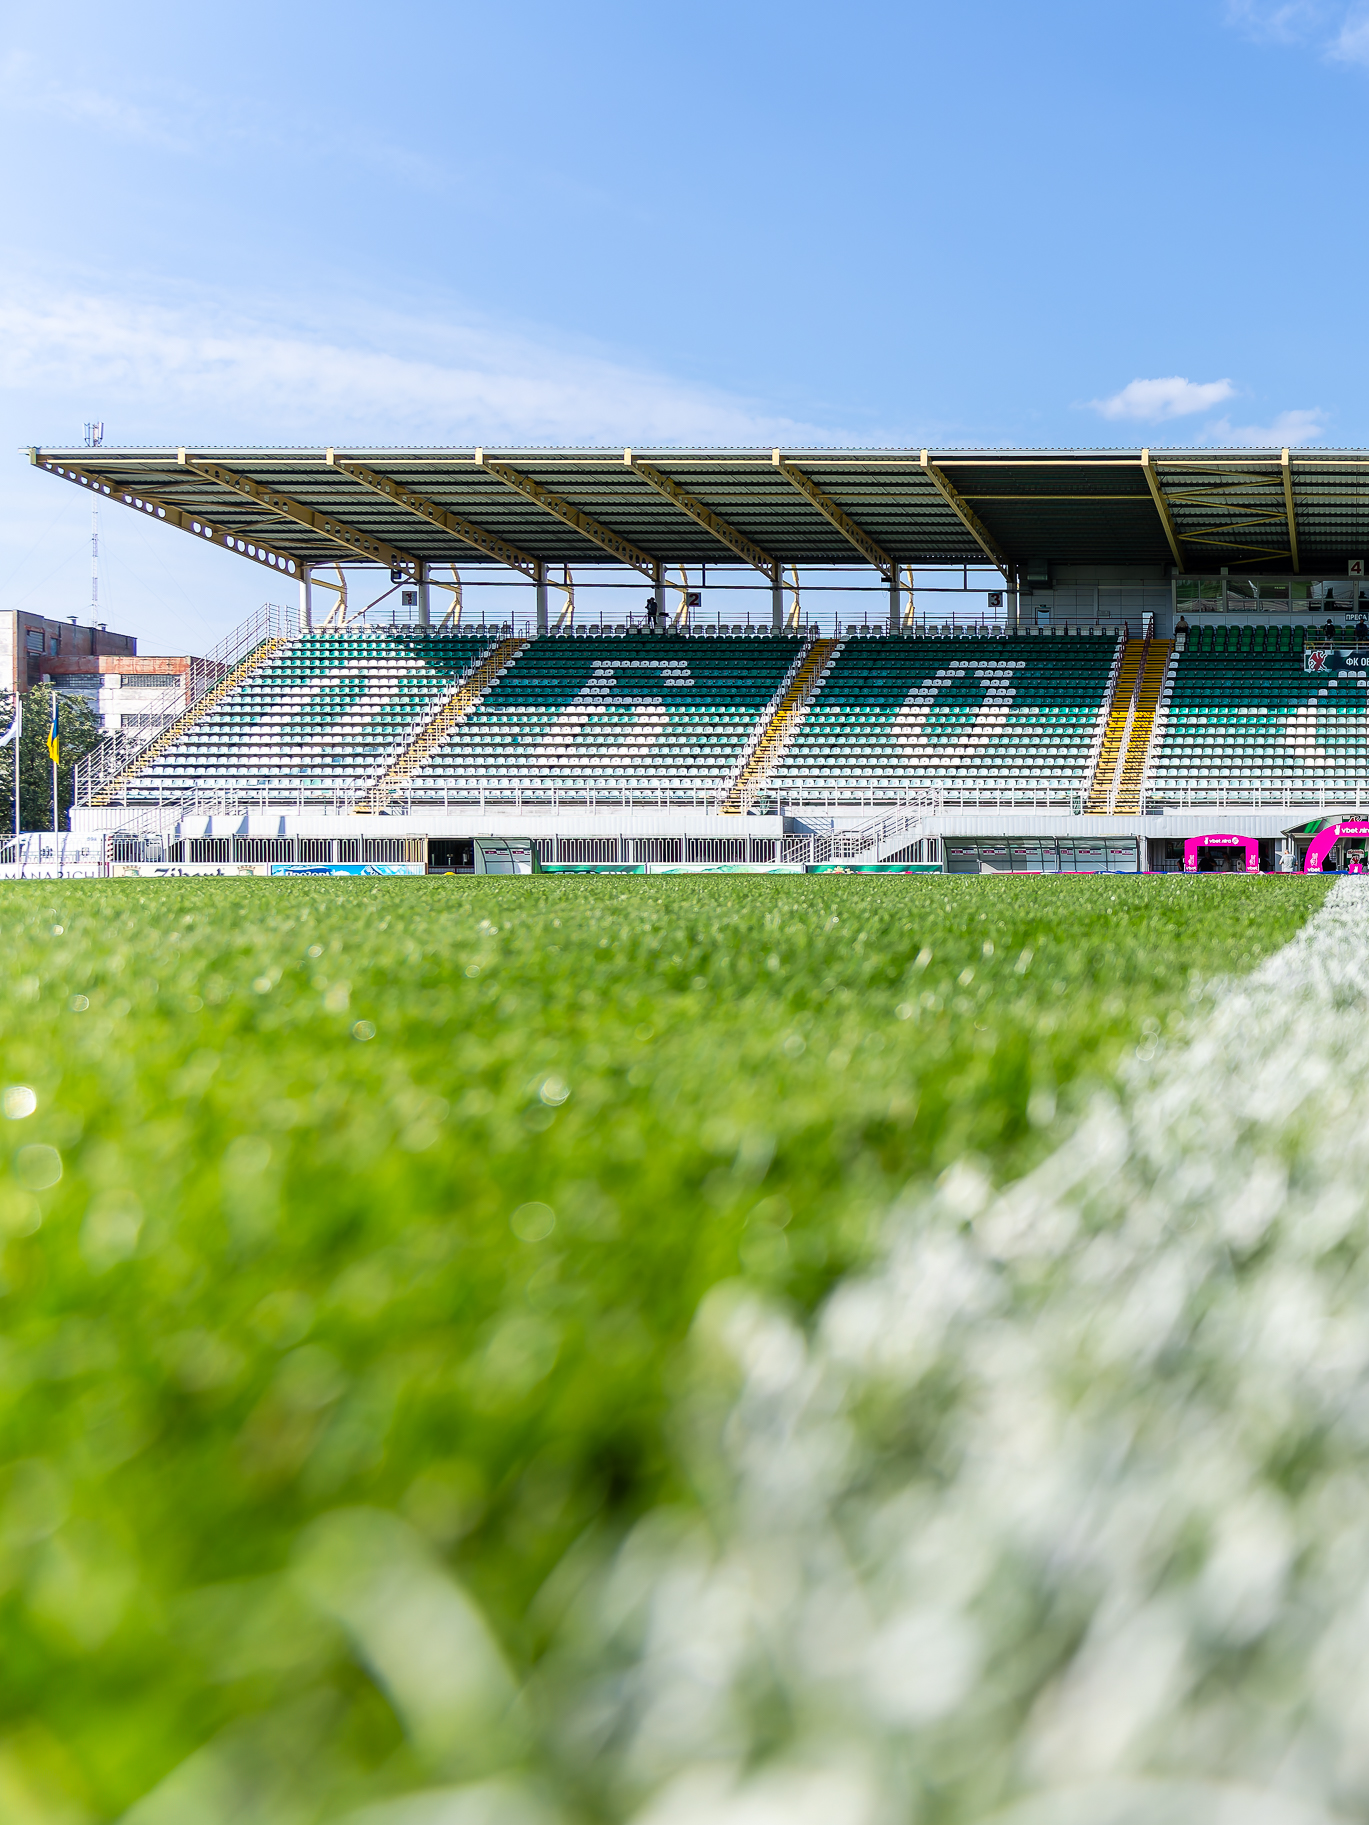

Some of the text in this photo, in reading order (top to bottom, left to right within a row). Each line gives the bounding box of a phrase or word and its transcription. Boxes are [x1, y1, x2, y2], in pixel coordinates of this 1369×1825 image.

[1350, 561, 1362, 574] 4
[689, 593, 700, 606] 2
[990, 593, 1001, 606] 3
[1345, 613, 1368, 621] ПРЕСА
[1345, 657, 1359, 667] ФК
